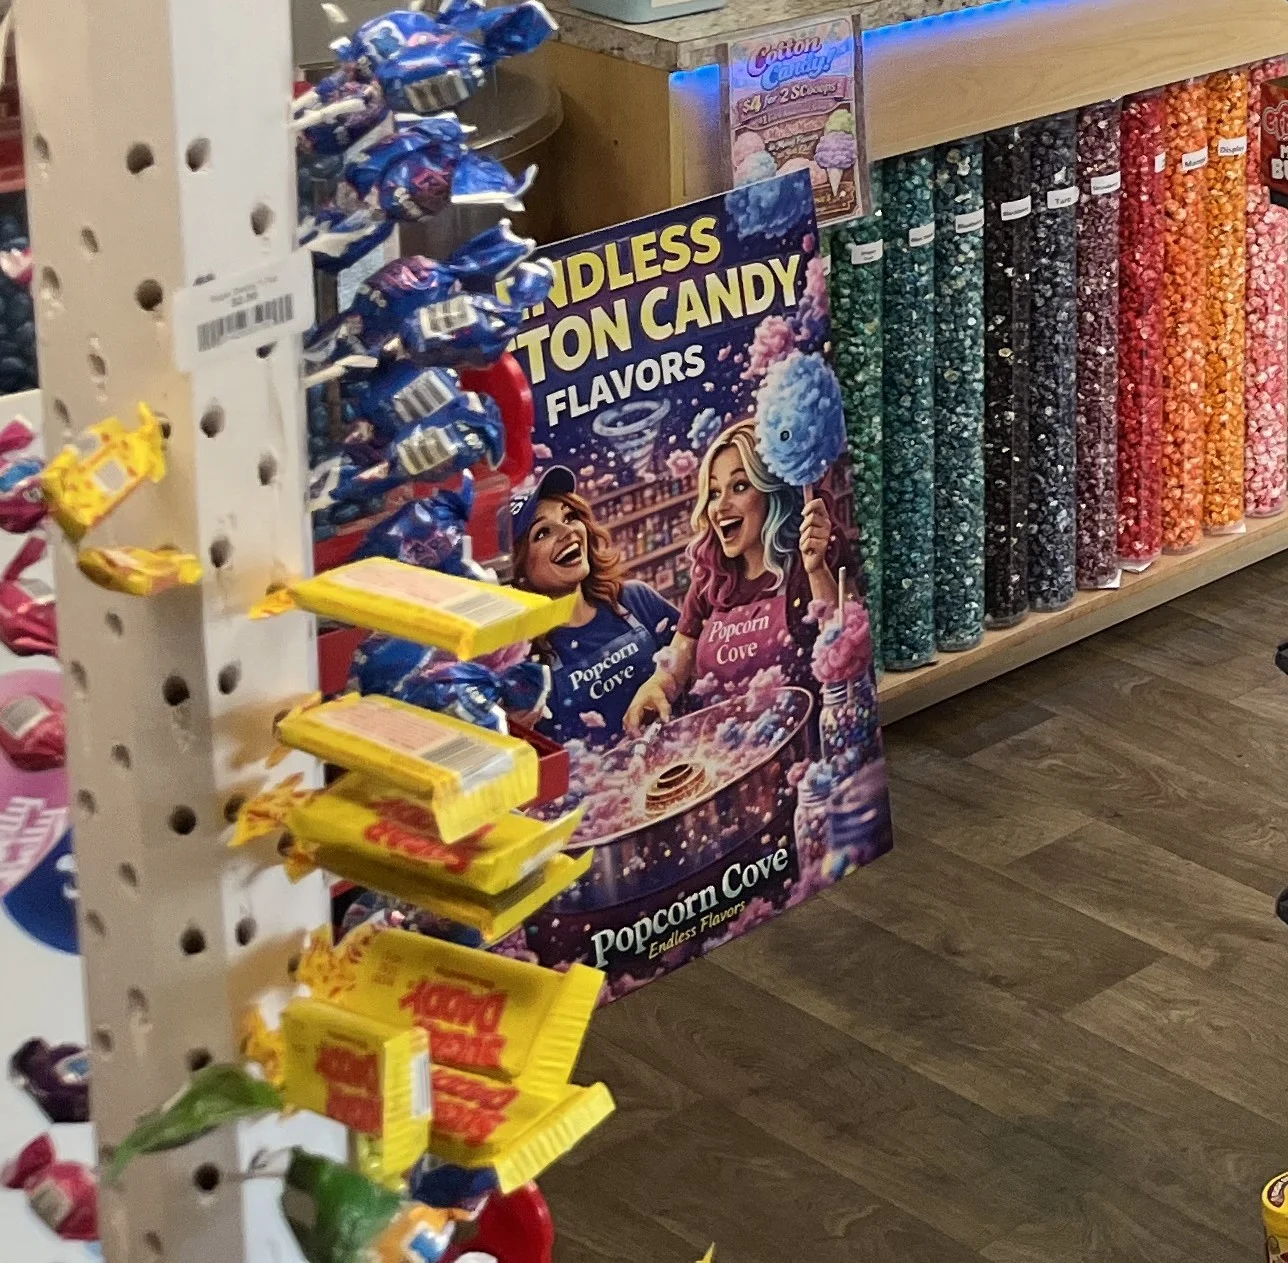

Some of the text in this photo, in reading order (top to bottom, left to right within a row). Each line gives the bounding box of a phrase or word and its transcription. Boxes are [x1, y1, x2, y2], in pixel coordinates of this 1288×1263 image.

[747, 36, 838, 91] Cotton Candy!
[1055, 196, 1072, 205] Taro
[497, 217, 721, 318] NDLESS
[511, 254, 802, 385] TON CANDY
[545, 345, 706, 428] FLAVORS
[708, 612, 770, 667] Popcorn Cove
[567, 640, 639, 701] Popcorn Cove
[591, 846, 789, 967] Popcorn Cove
[648, 900, 746, 960] Endless Flavors
